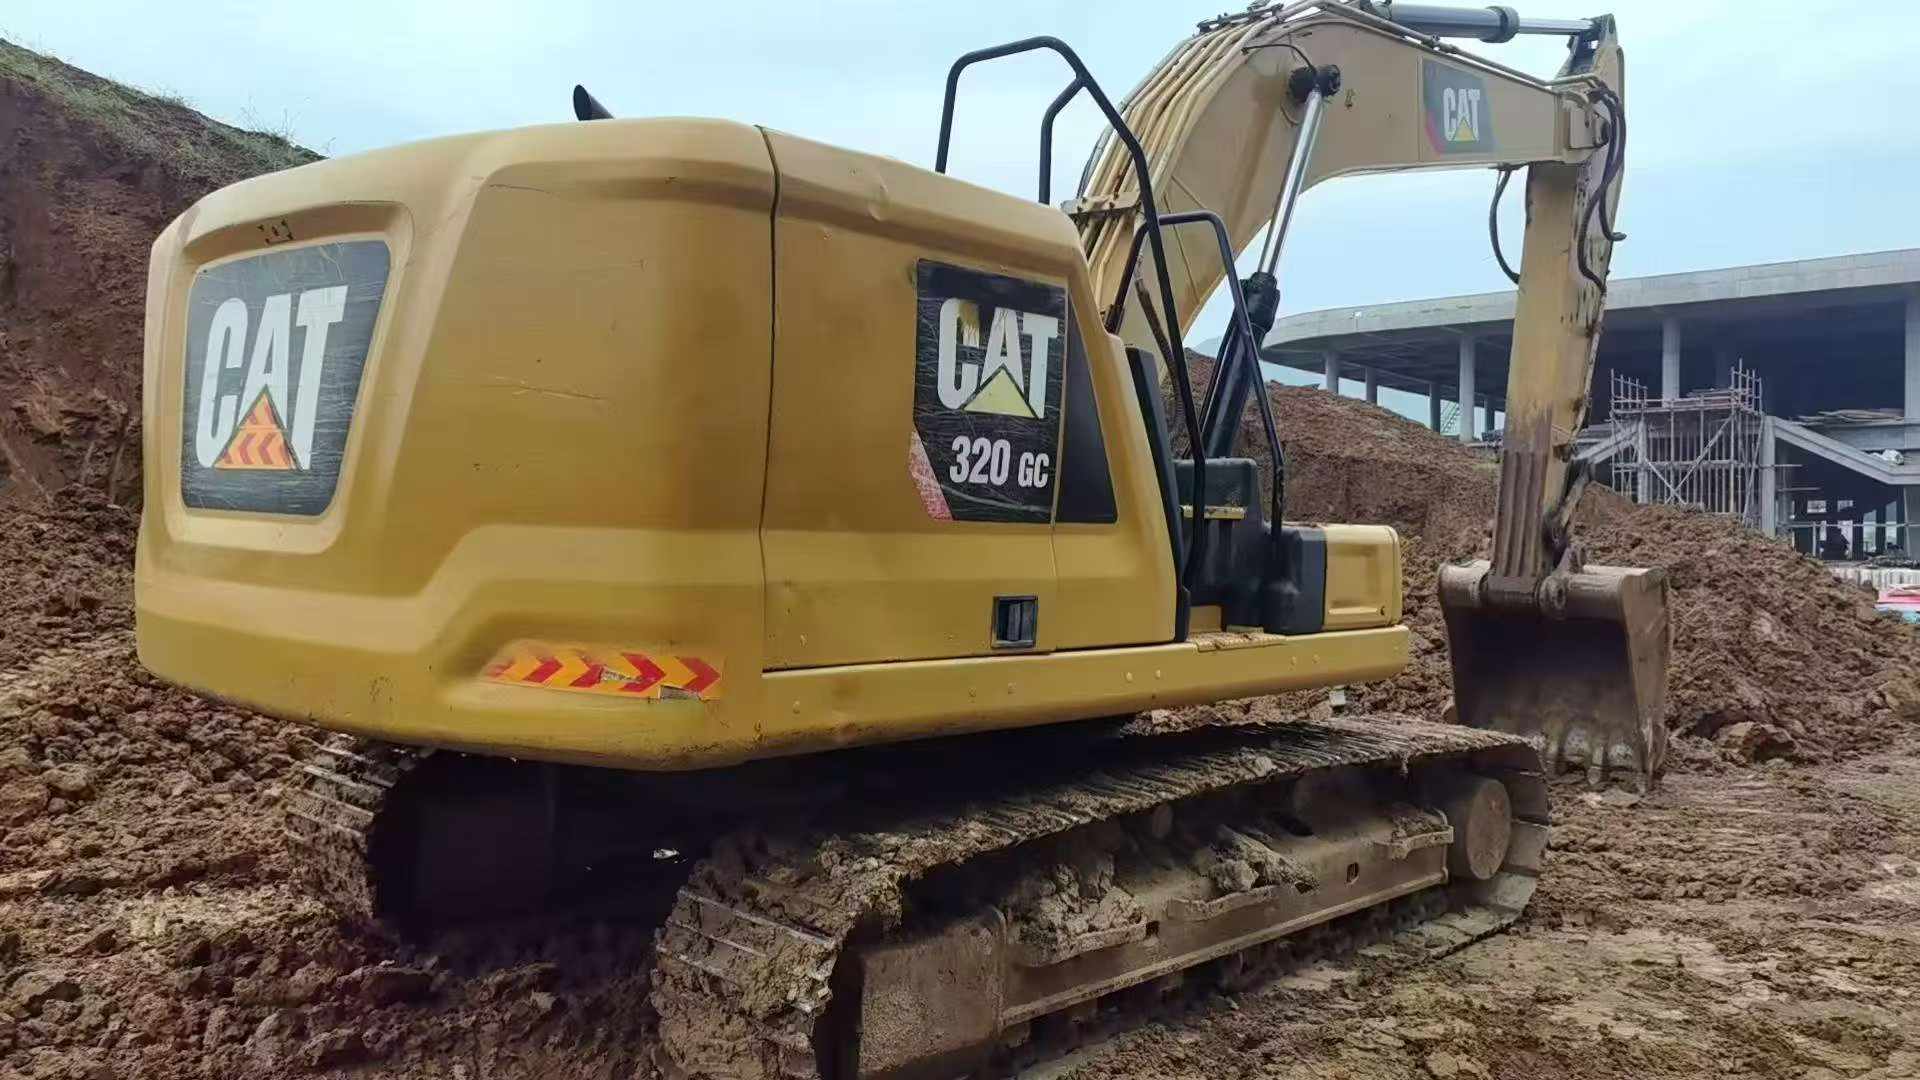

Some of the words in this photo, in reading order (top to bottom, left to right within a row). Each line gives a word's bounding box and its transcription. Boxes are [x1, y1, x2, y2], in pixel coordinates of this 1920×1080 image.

[1443, 87, 1480, 142] CAT
[195, 285, 349, 470] CAT
[937, 297, 1059, 419] CAT
[949, 436, 1011, 486] 320
[1018, 451, 1050, 488] GC
